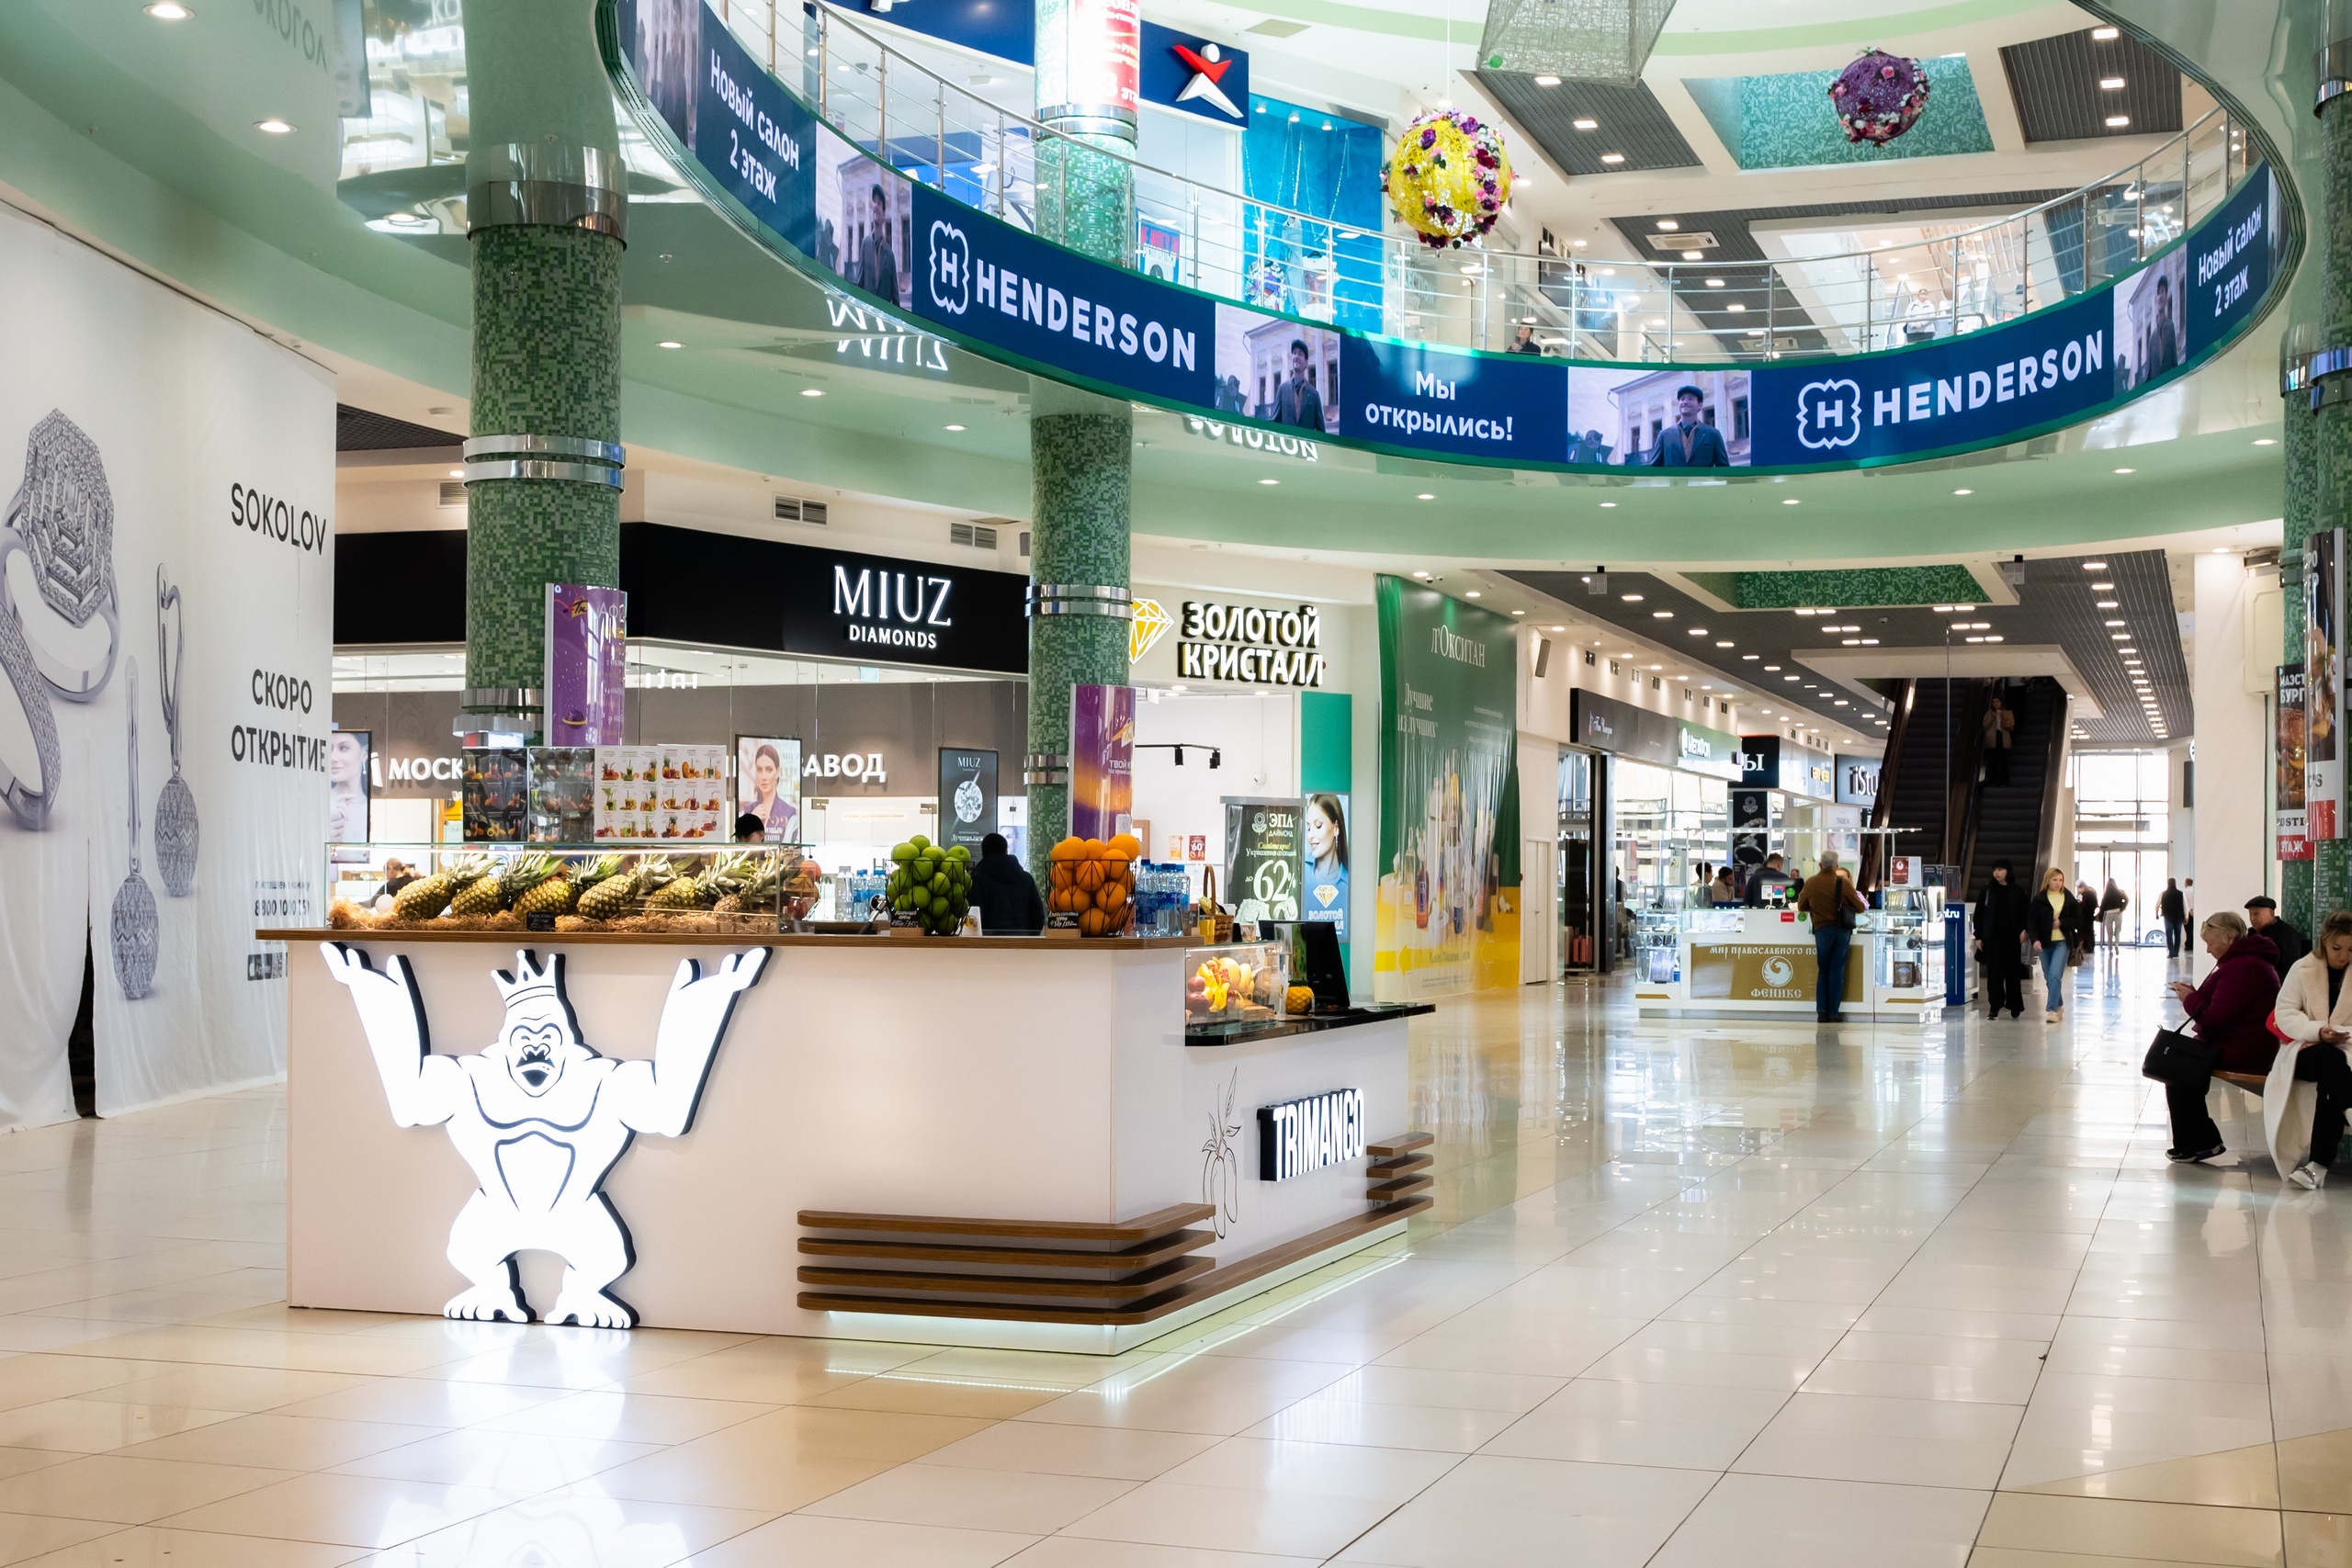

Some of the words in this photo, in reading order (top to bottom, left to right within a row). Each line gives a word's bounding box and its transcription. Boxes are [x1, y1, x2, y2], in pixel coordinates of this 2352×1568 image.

[710, 49, 753, 130] Новый
[757, 111, 799, 172] салон
[729, 129, 739, 169] 2
[741, 152, 777, 204] этаж
[2198, 233, 2233, 287] Новый
[2234, 203, 2263, 254] салон
[977, 259, 1195, 371] HENDERSON
[2214, 291, 2222, 317] 2
[2223, 274, 2249, 310] этаж
[1416, 370, 1456, 400] Мы
[1873, 330, 2104, 426] HENDERSON
[1365, 402, 1513, 441] открылись!
[231, 483, 327, 557] SOKOLOV
[833, 566, 952, 626] MIUZ
[849, 625, 937, 649] DIAMONDS
[1185, 603, 1321, 646] ЗОЛОТОЙ
[1183, 644, 1324, 685] КРИСТАЛЛ
[251, 669, 313, 716] СКОРО
[1404, 682, 1433, 713] Лучшие
[1397, 714, 1408, 733] из
[231, 724, 327, 775] ОТКРЫТИЕ
[802, 753, 888, 783] АВОД
[957, 757, 981, 768] MIUZ
[1109, 759, 1126, 770] ТВОЙ
[1742, 753, 1765, 772] Ы
[1854, 765, 1881, 796] iStu
[1269, 813, 1294, 828] ЭПЛ
[1269, 829, 1294, 837] ДАЙМОНД
[1253, 860, 1296, 901] 62%
[1805, 947, 1817, 955] ПО
[1751, 988, 1802, 998] ФЕНИКС
[1272, 1088, 1365, 1183] TRIMANGO
